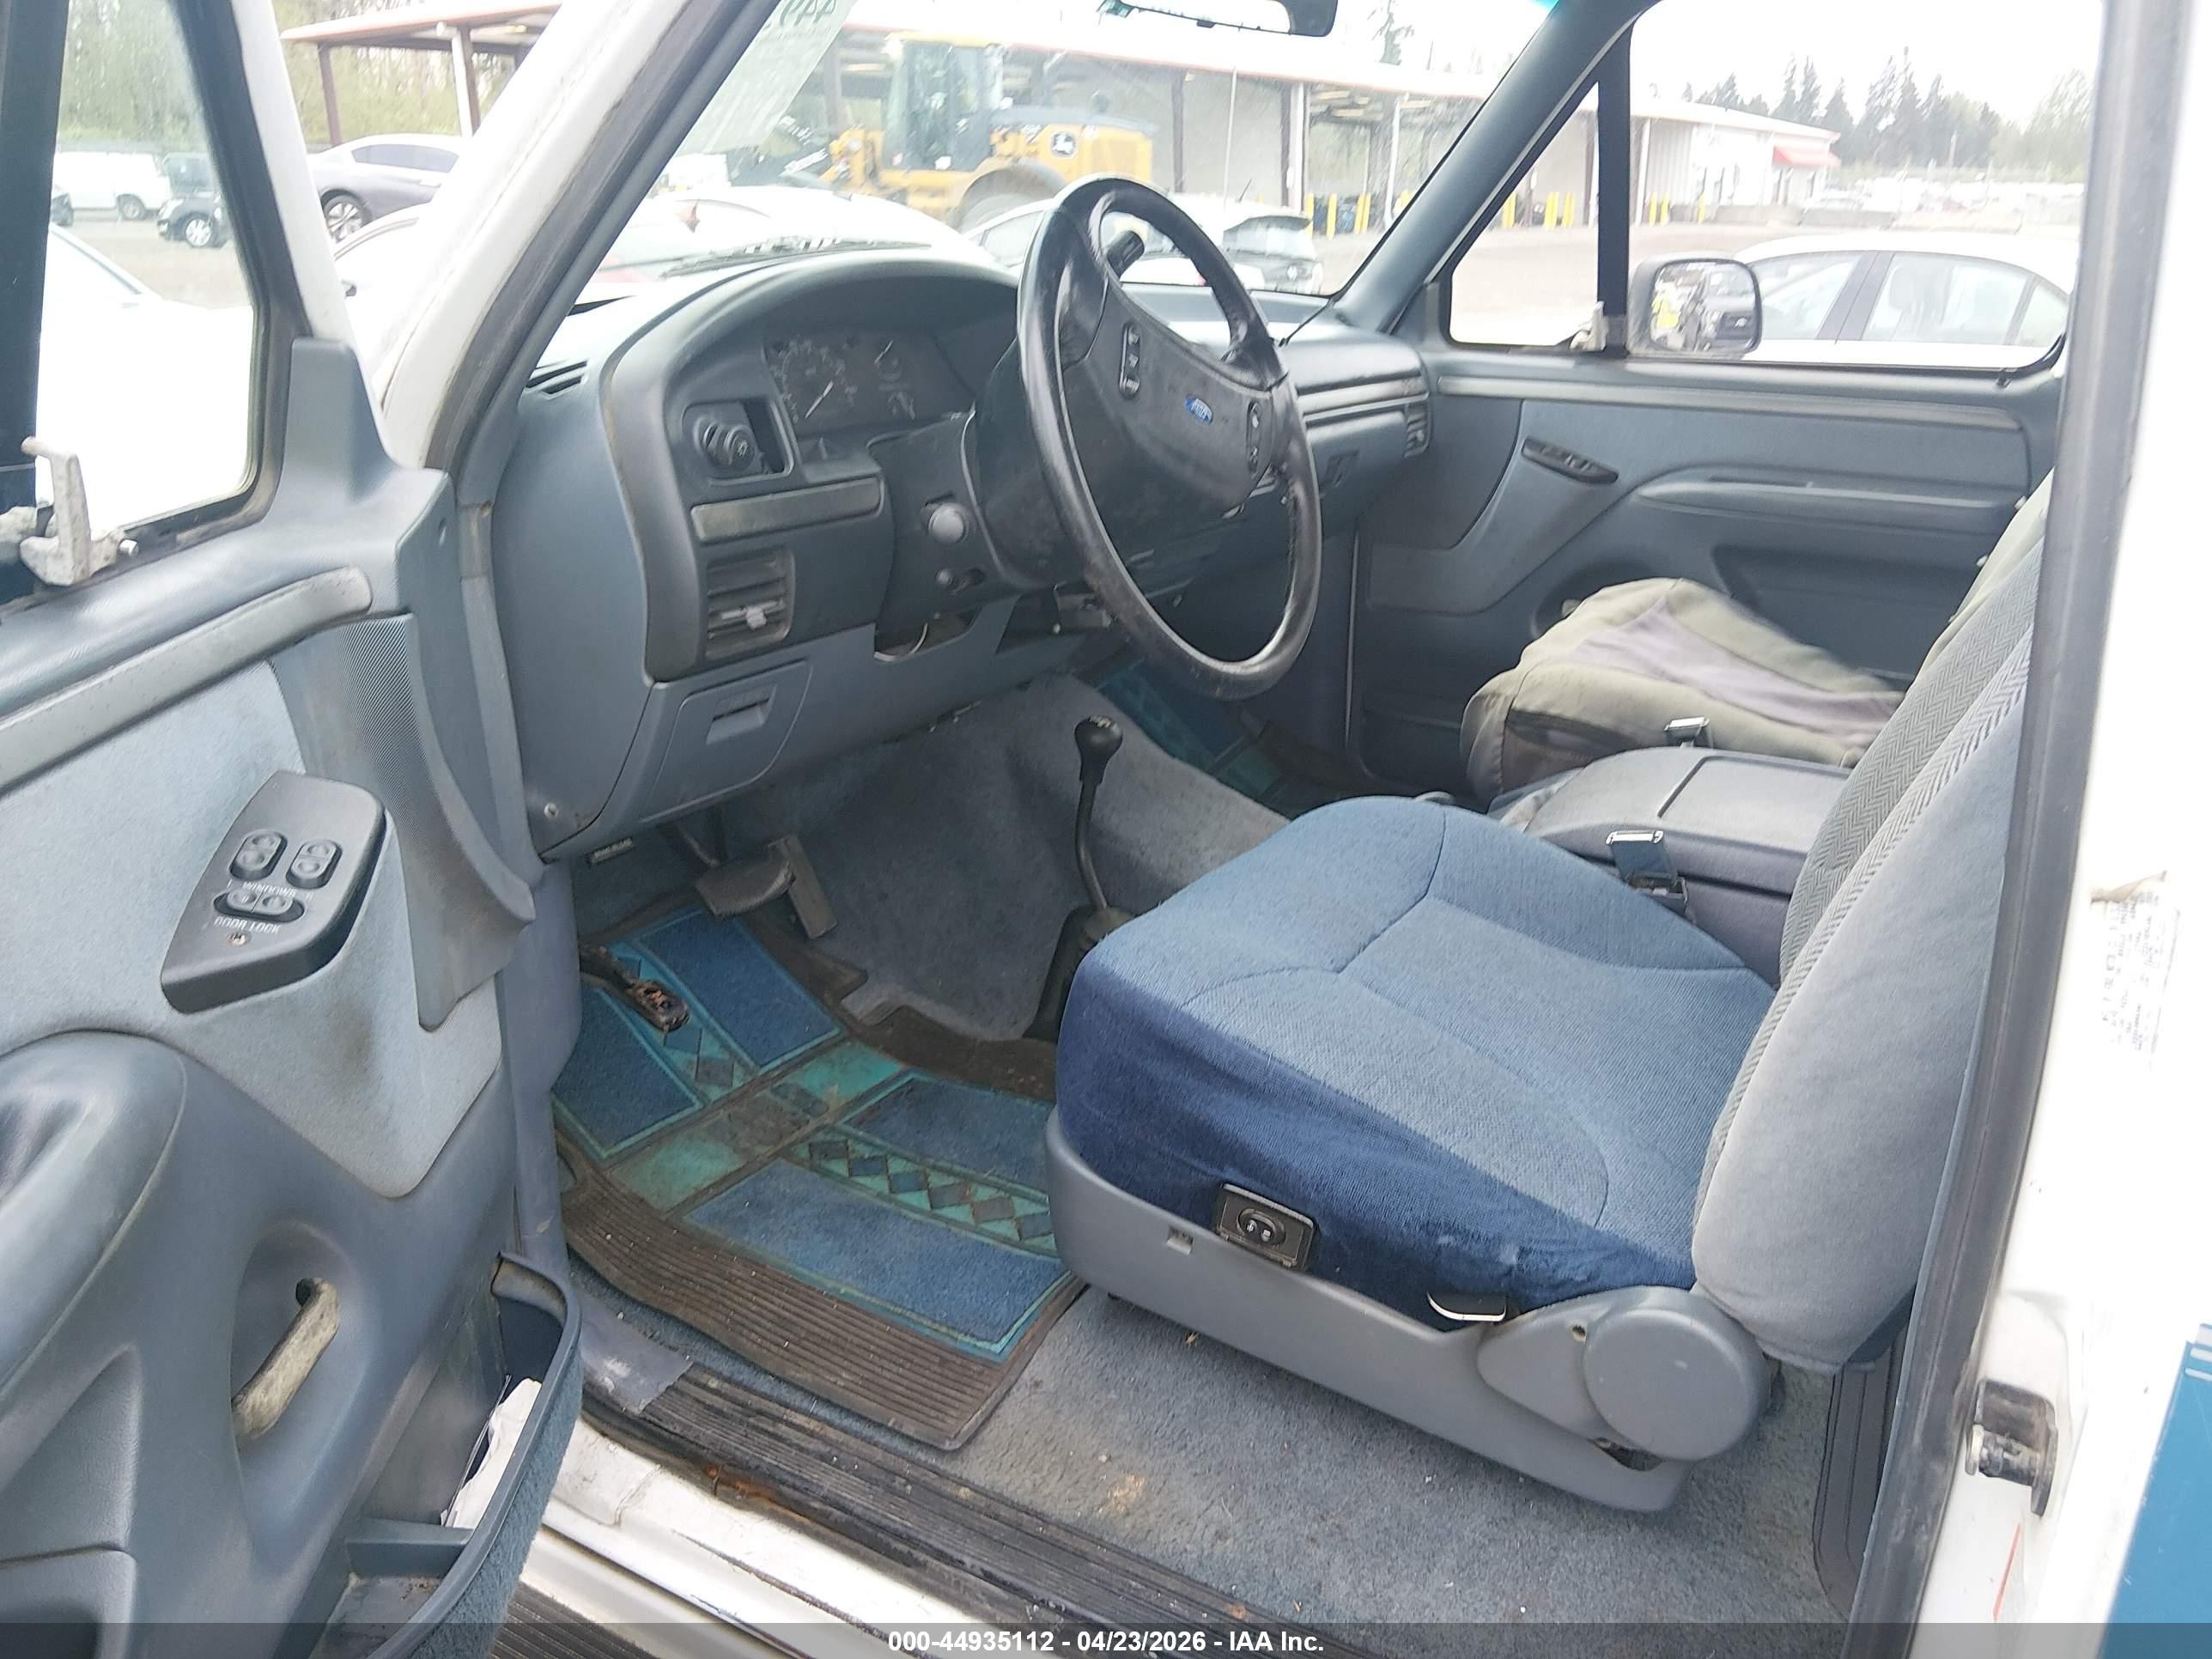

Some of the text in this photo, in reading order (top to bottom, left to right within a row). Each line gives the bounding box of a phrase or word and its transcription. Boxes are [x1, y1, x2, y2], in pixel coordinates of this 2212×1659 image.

[244, 881, 297, 897] WINDOWS
[215, 916, 281, 933] DOOR LOCK
